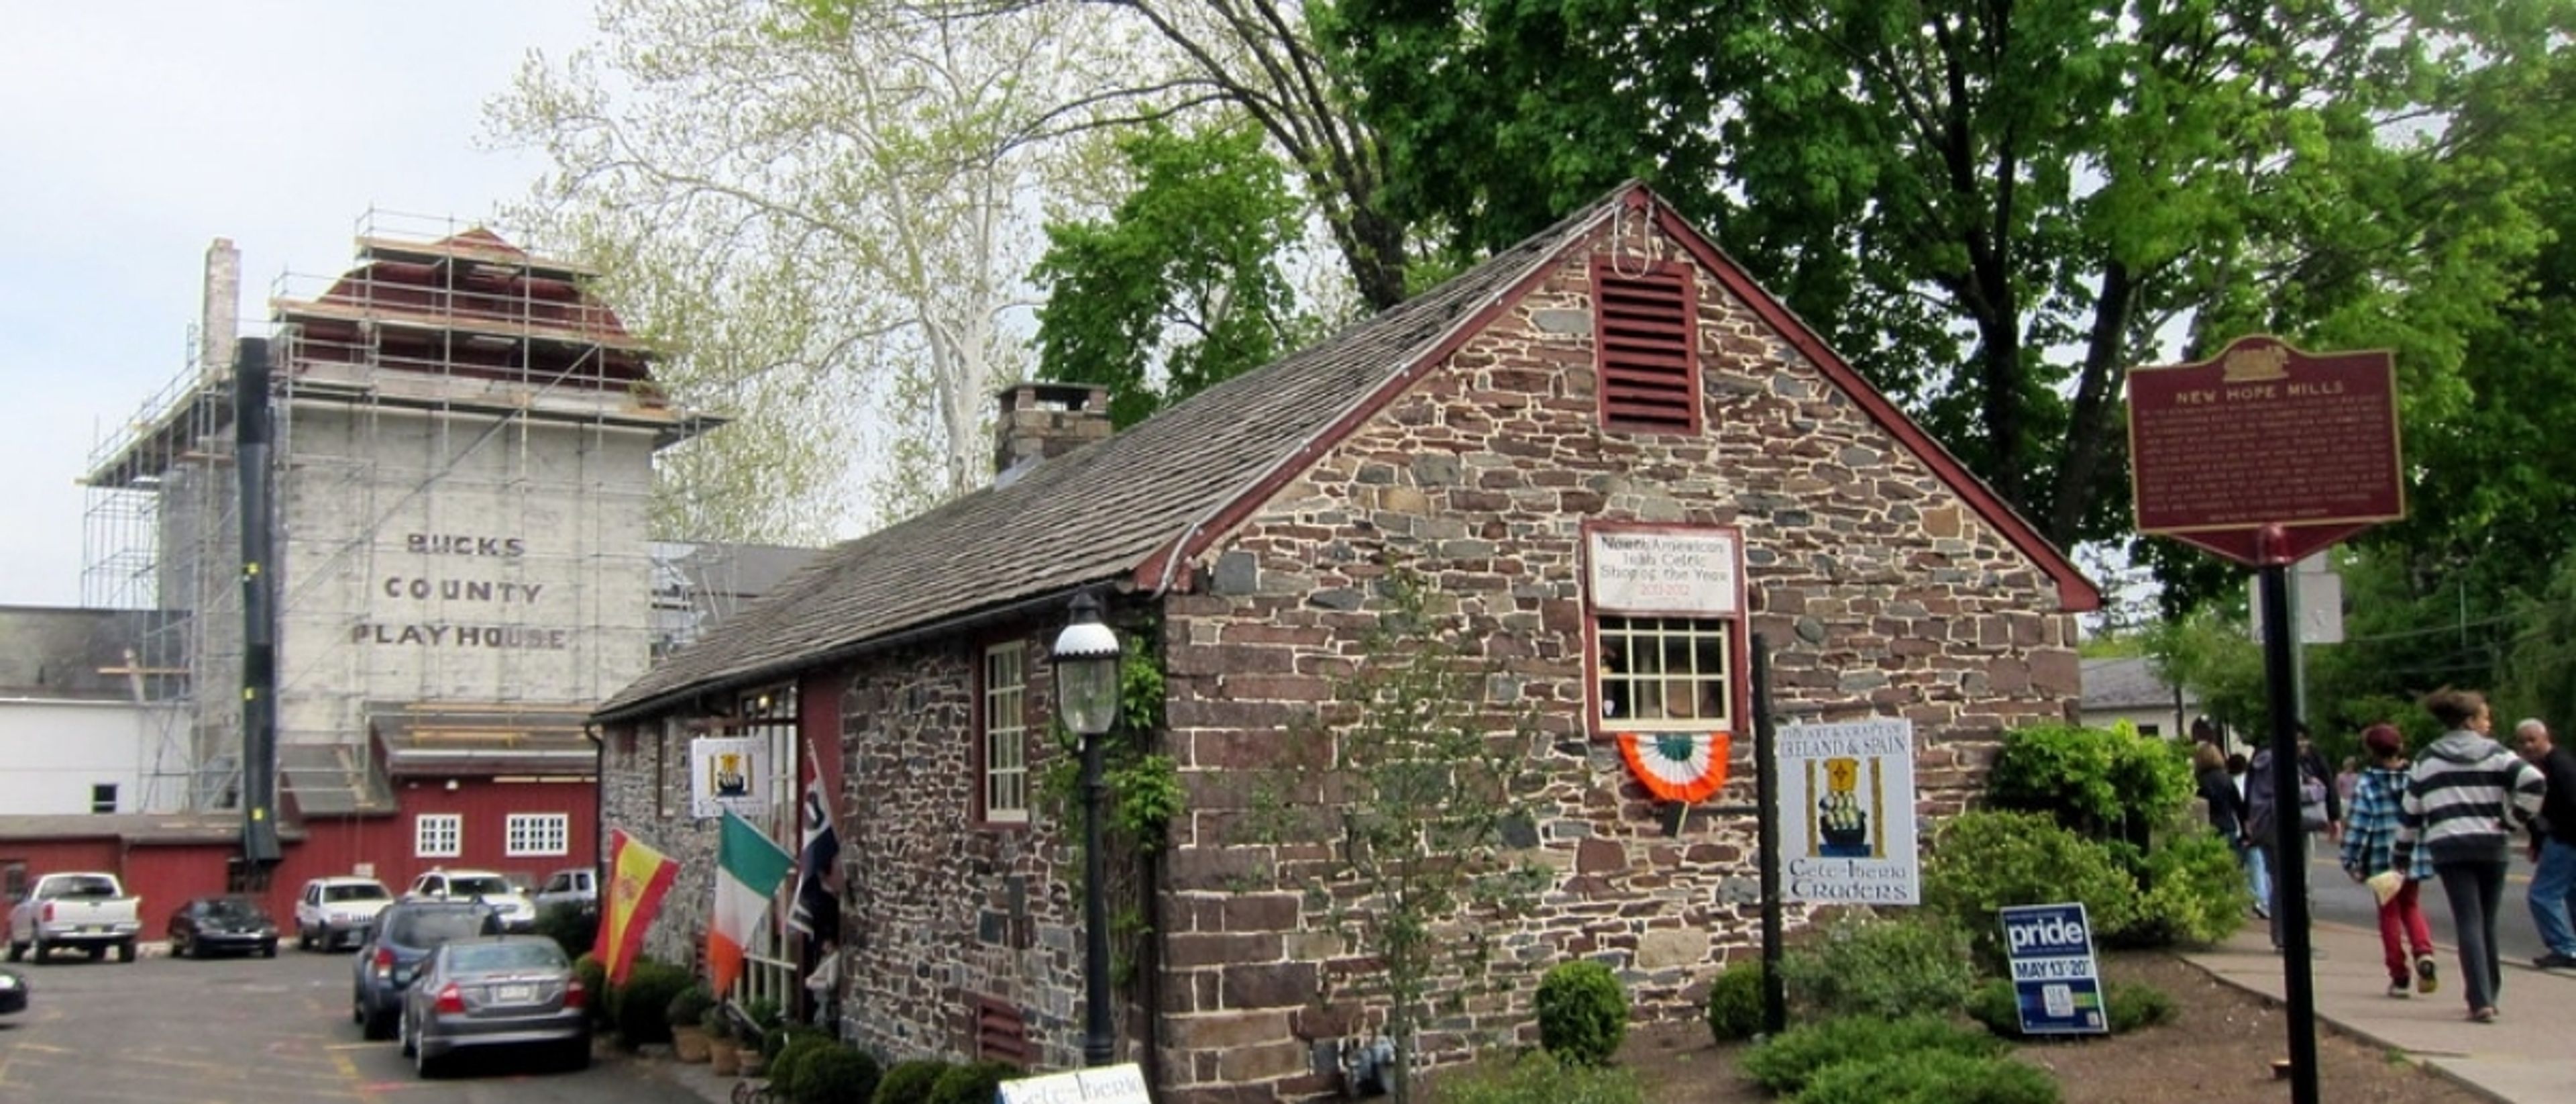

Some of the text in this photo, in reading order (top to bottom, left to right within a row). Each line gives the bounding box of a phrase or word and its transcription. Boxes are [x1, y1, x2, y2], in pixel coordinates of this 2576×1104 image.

[2176, 380, 2344, 404] NEW HOPE MILLS
[407, 533, 525, 558] BUCKS
[384, 576, 543, 604] COUNTY
[352, 624, 565, 650] PLAYHOUSE
[1780, 736, 1907, 758] IRELAND & SPAIN
[2008, 917, 2083, 954] pride
[2015, 961, 2047, 978] MAY
